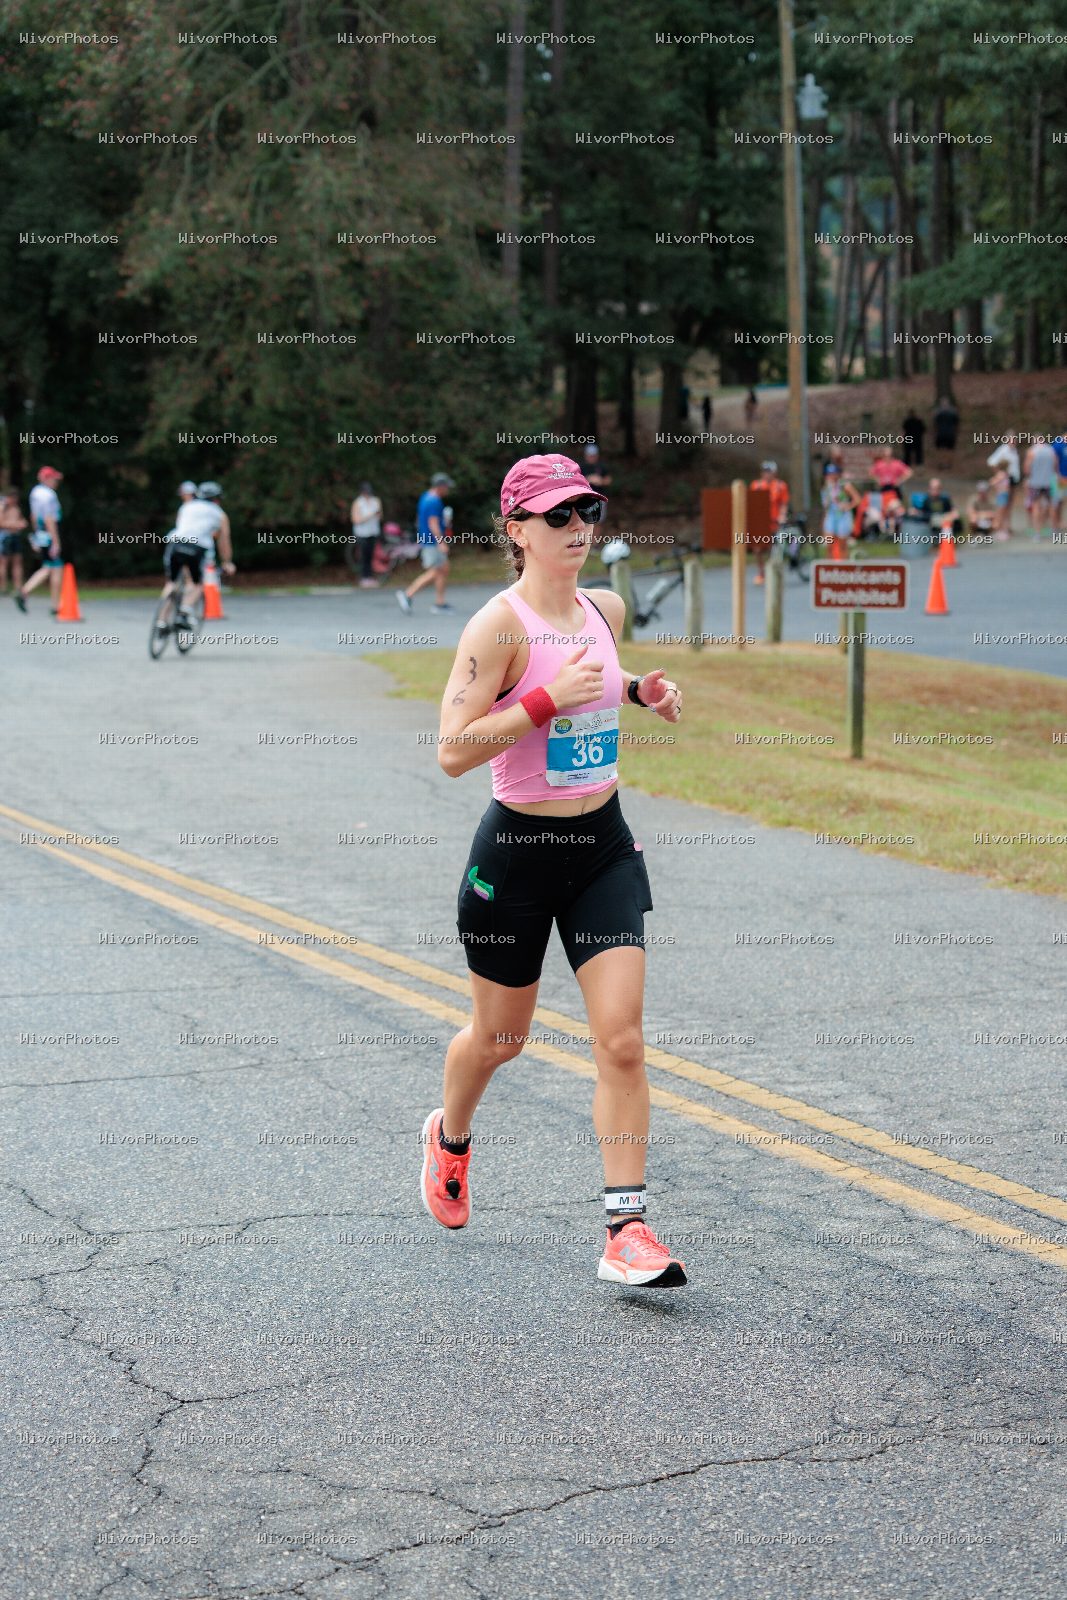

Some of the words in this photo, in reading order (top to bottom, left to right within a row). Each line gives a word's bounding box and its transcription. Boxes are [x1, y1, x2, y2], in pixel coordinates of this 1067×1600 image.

[819, 567, 902, 585] Intoxicants
[820, 588, 899, 605] Prohibited
[572, 739, 603, 768] 36
